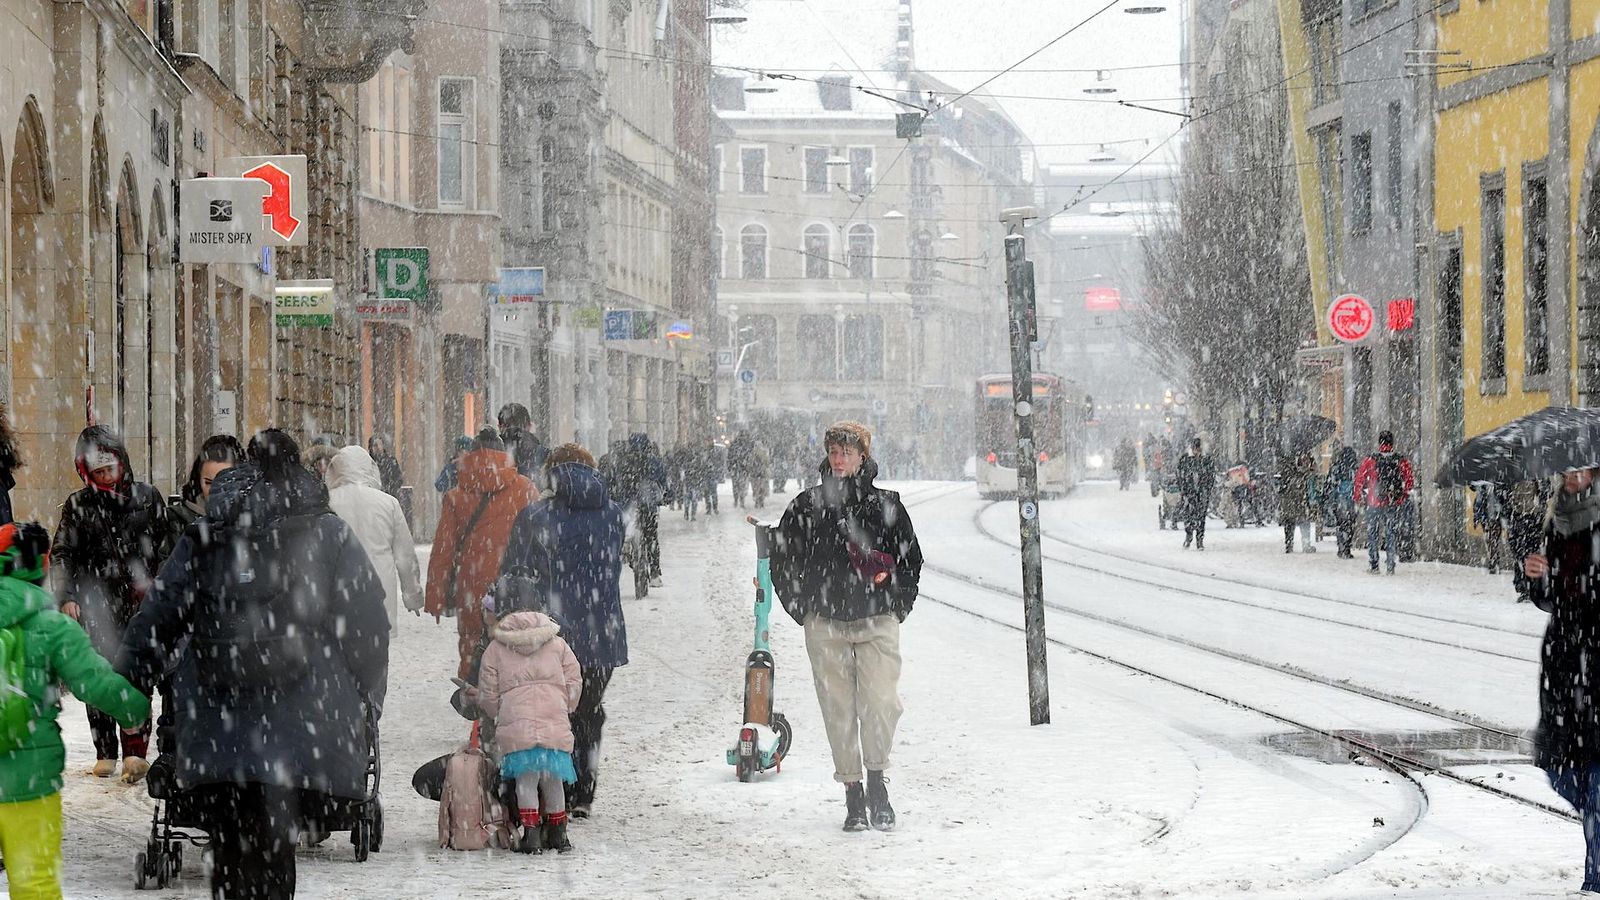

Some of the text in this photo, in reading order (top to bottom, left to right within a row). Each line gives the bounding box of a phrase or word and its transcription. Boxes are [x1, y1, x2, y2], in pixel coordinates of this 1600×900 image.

[189, 232, 252, 244] MISTER SPEX
[387, 258, 419, 291] D
[275, 295, 318, 307] GEERS
